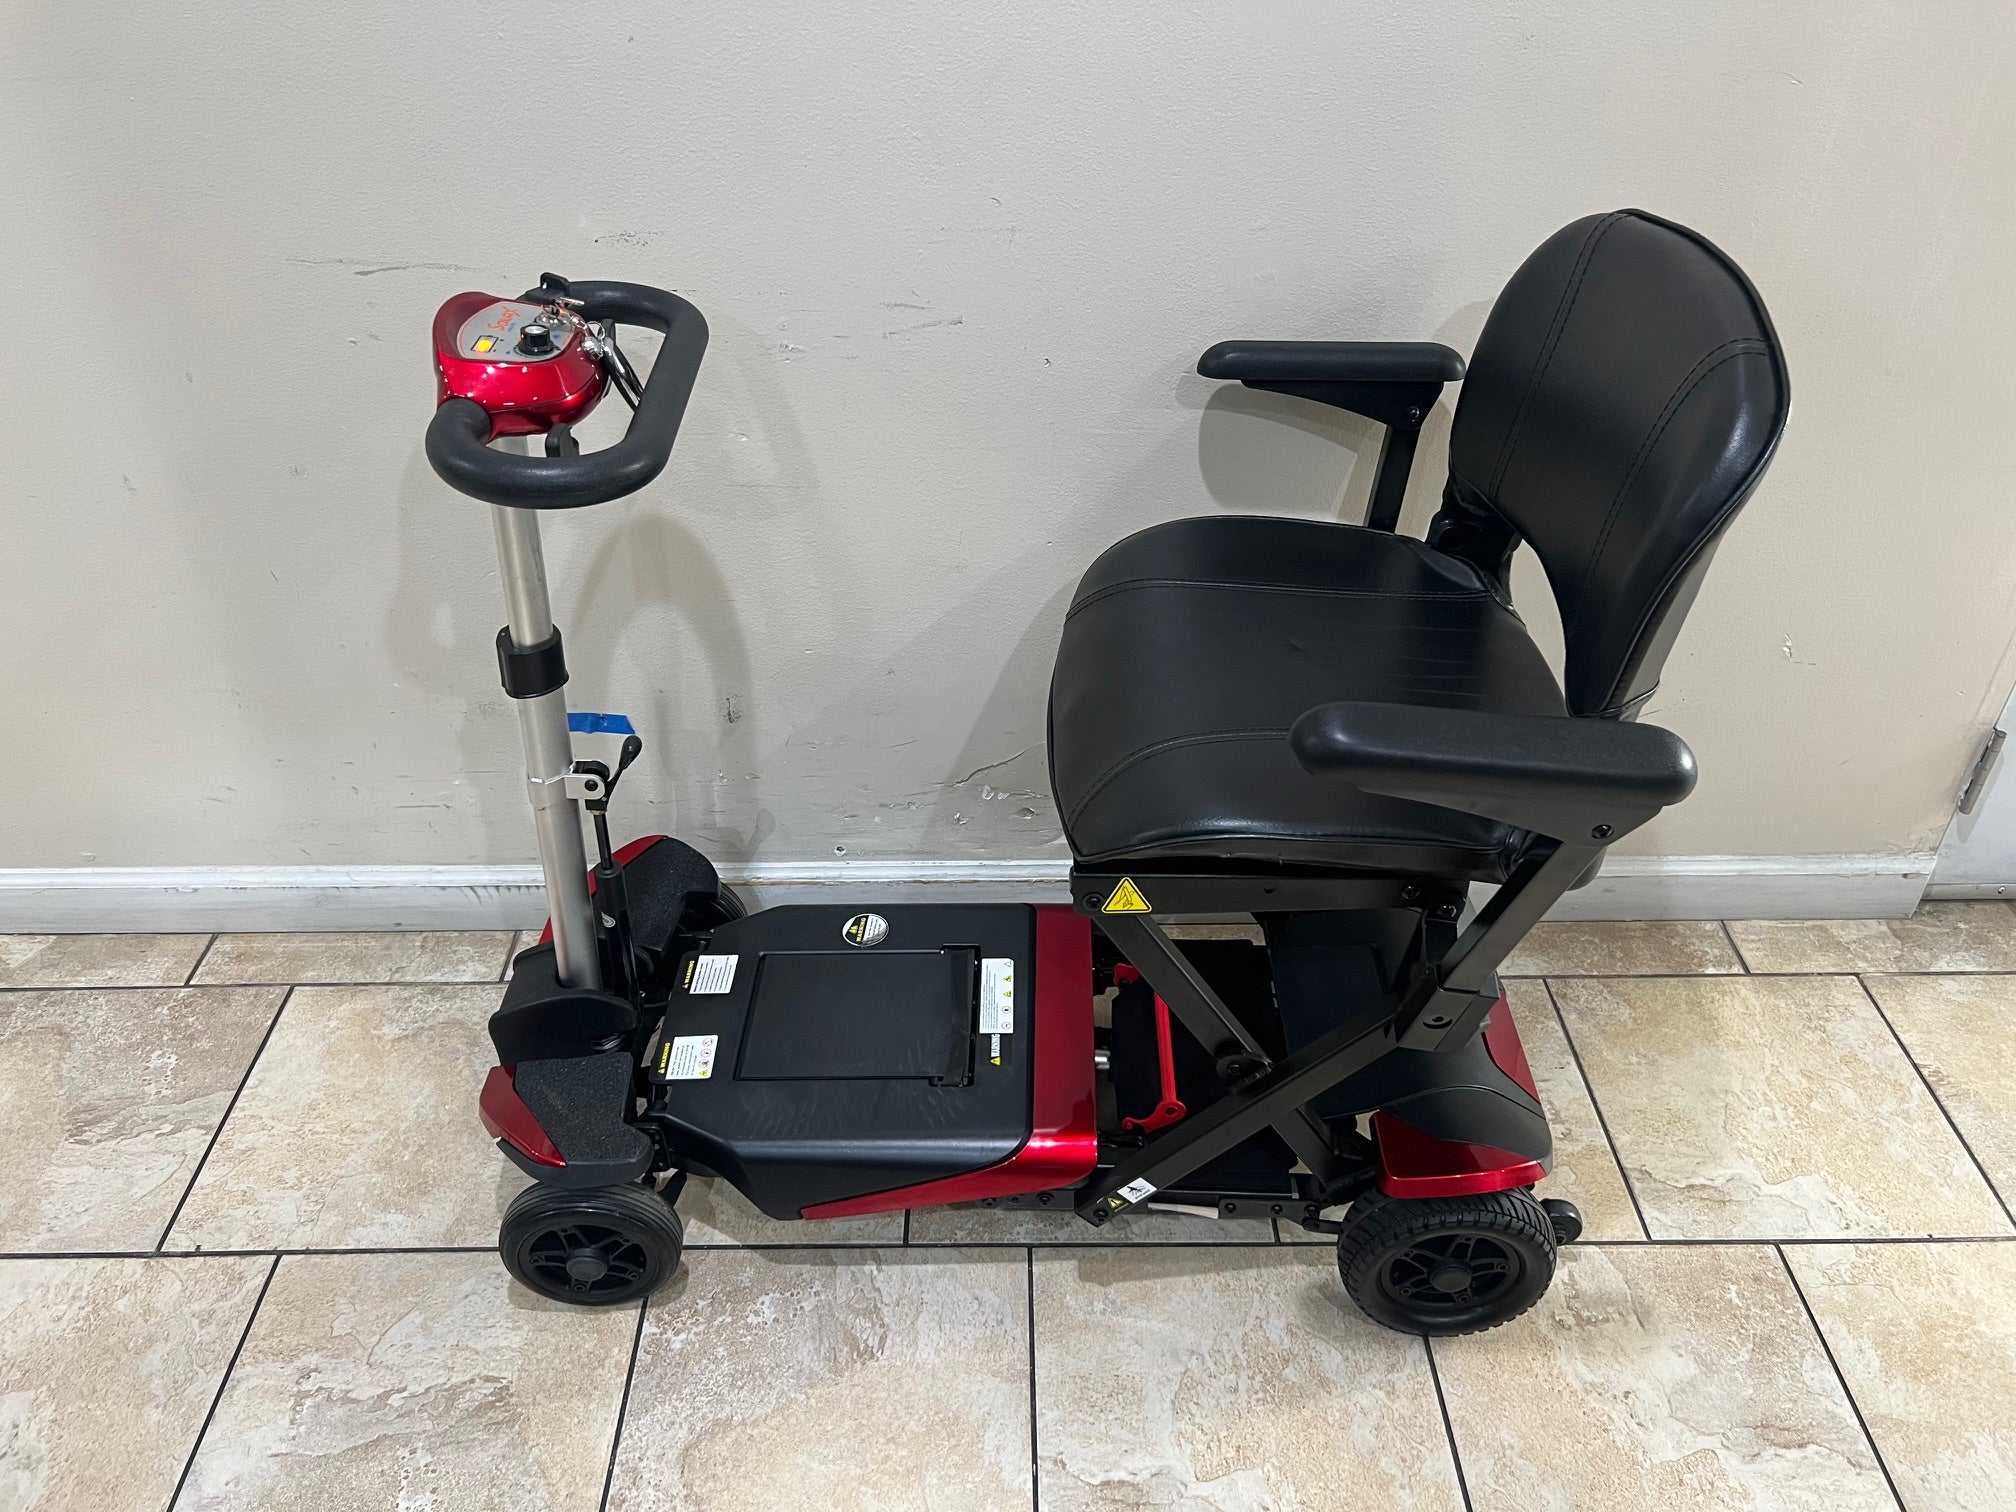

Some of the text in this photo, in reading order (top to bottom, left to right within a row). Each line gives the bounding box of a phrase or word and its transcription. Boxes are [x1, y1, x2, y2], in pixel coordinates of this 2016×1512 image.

[856, 917, 866, 942] WARNING
[684, 960, 695, 984] WARNING
[660, 1042, 670, 1068] WARNING
[991, 1034, 1000, 1057] WARNING
